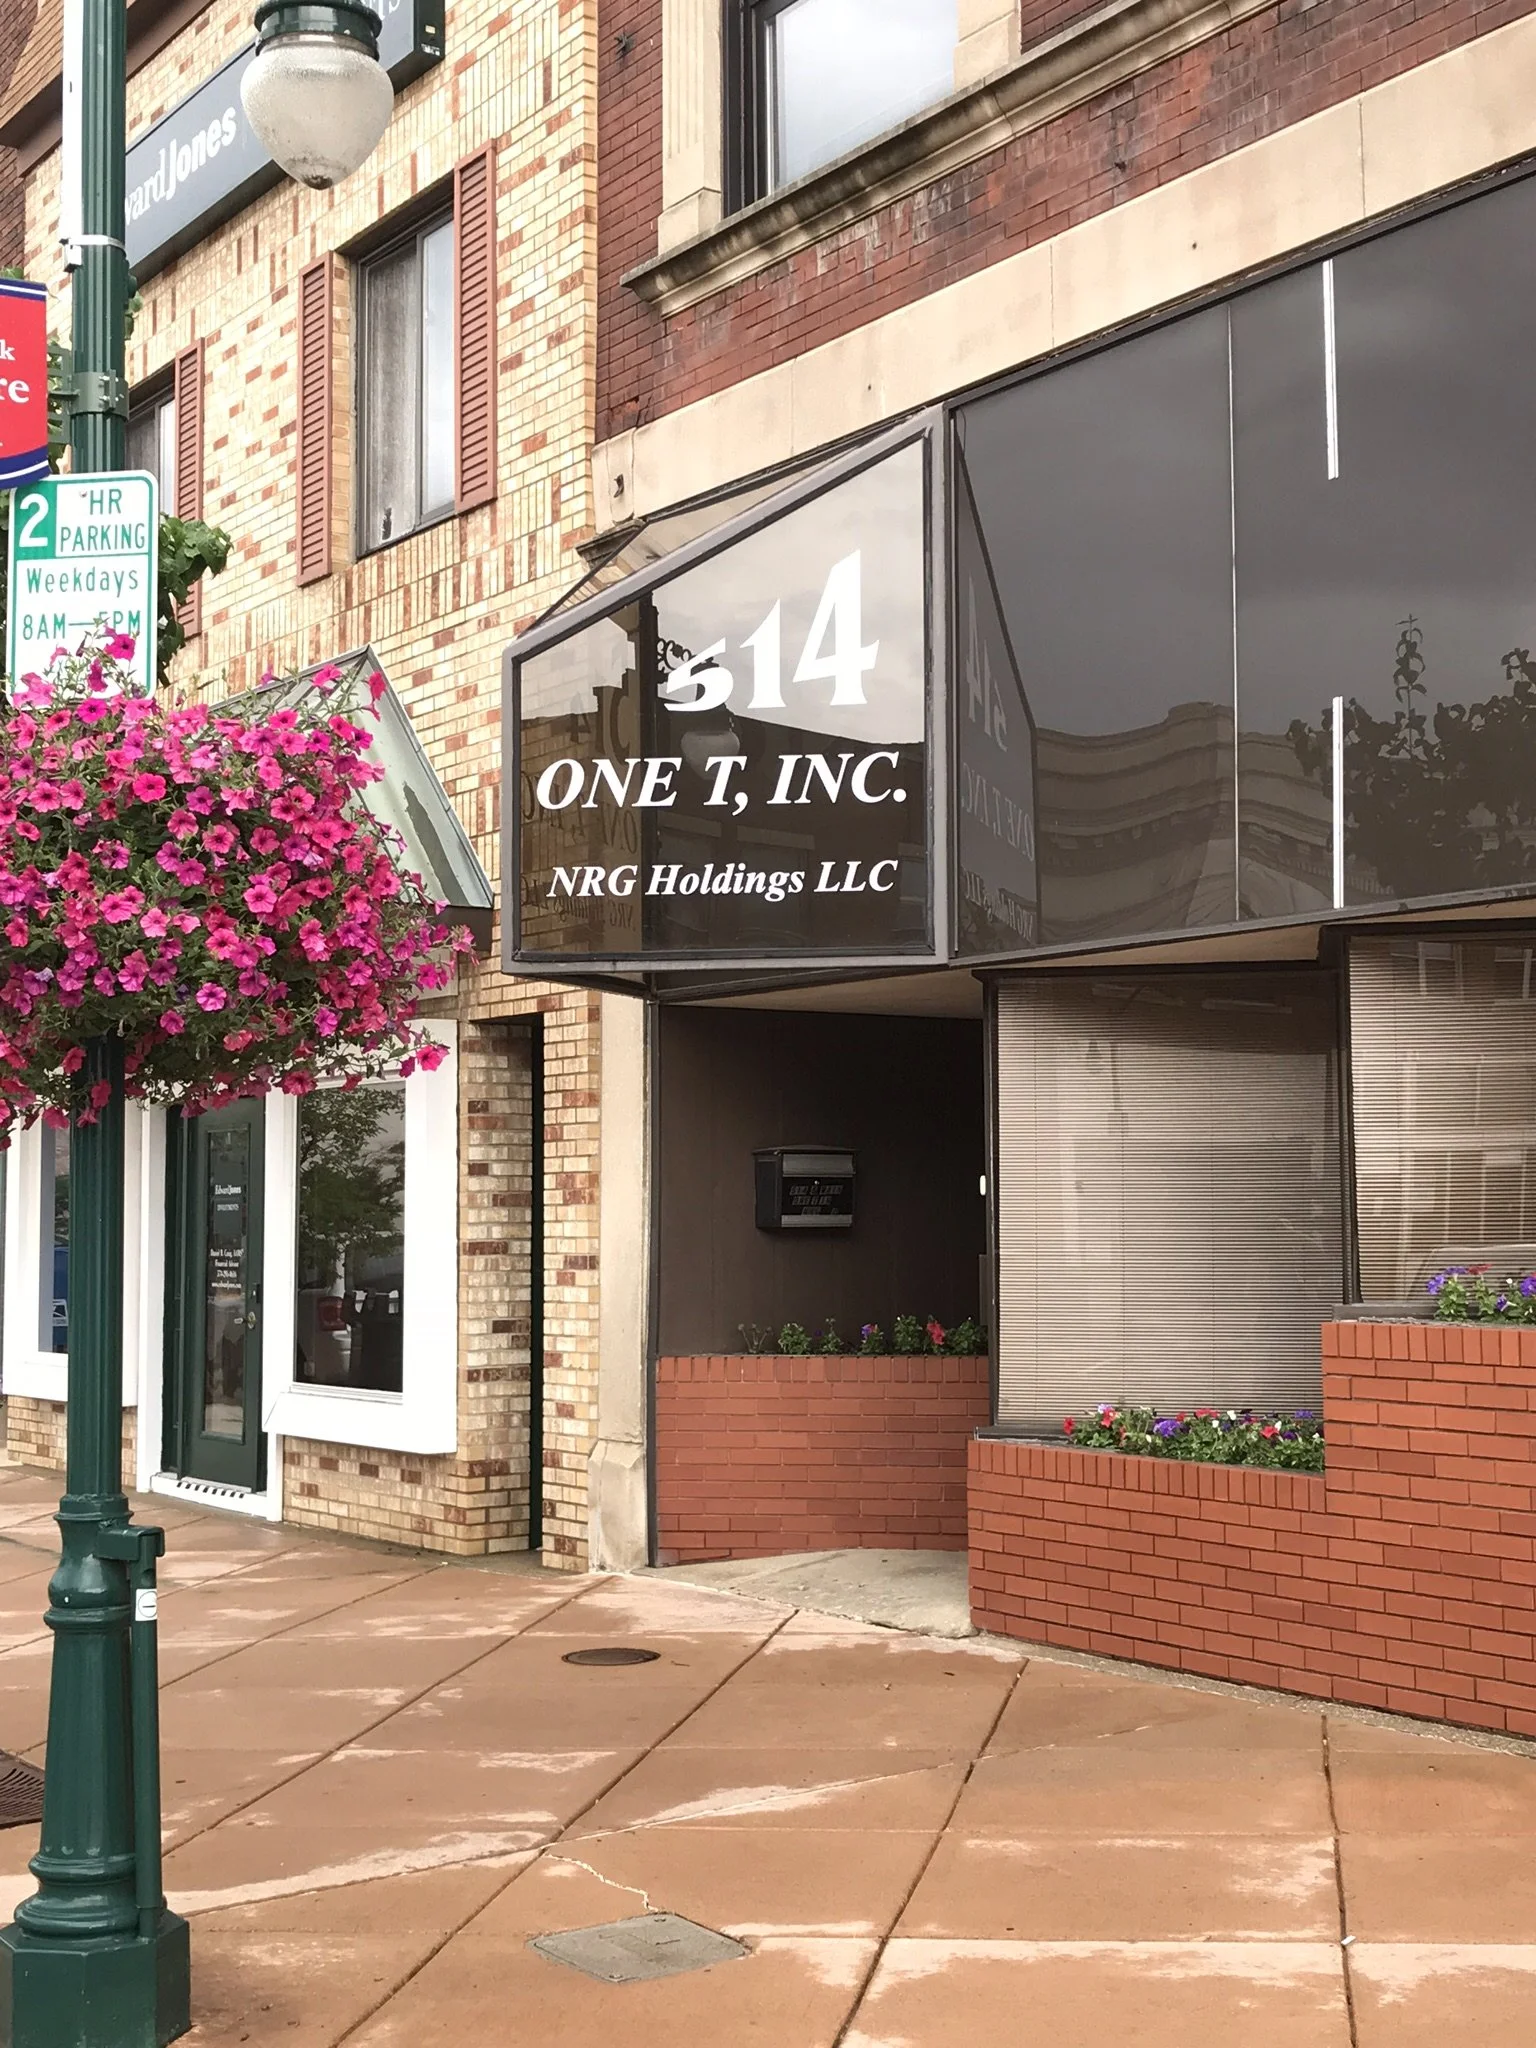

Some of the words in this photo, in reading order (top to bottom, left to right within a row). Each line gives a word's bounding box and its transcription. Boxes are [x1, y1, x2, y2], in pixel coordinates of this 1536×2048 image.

[19, 493, 49, 548] 2
[90, 489, 122, 515] HR
[60, 523, 145, 552] PARKING
[27, 566, 139, 598] Weekdays
[664, 550, 880, 712] 514
[536, 757, 682, 810] ONE
[703, 755, 748, 816] T,
[766, 751, 907, 804] INC.
[546, 865, 638, 897] NRG
[644, 862, 805, 905] Holdings
[813, 859, 899, 892] LLC
